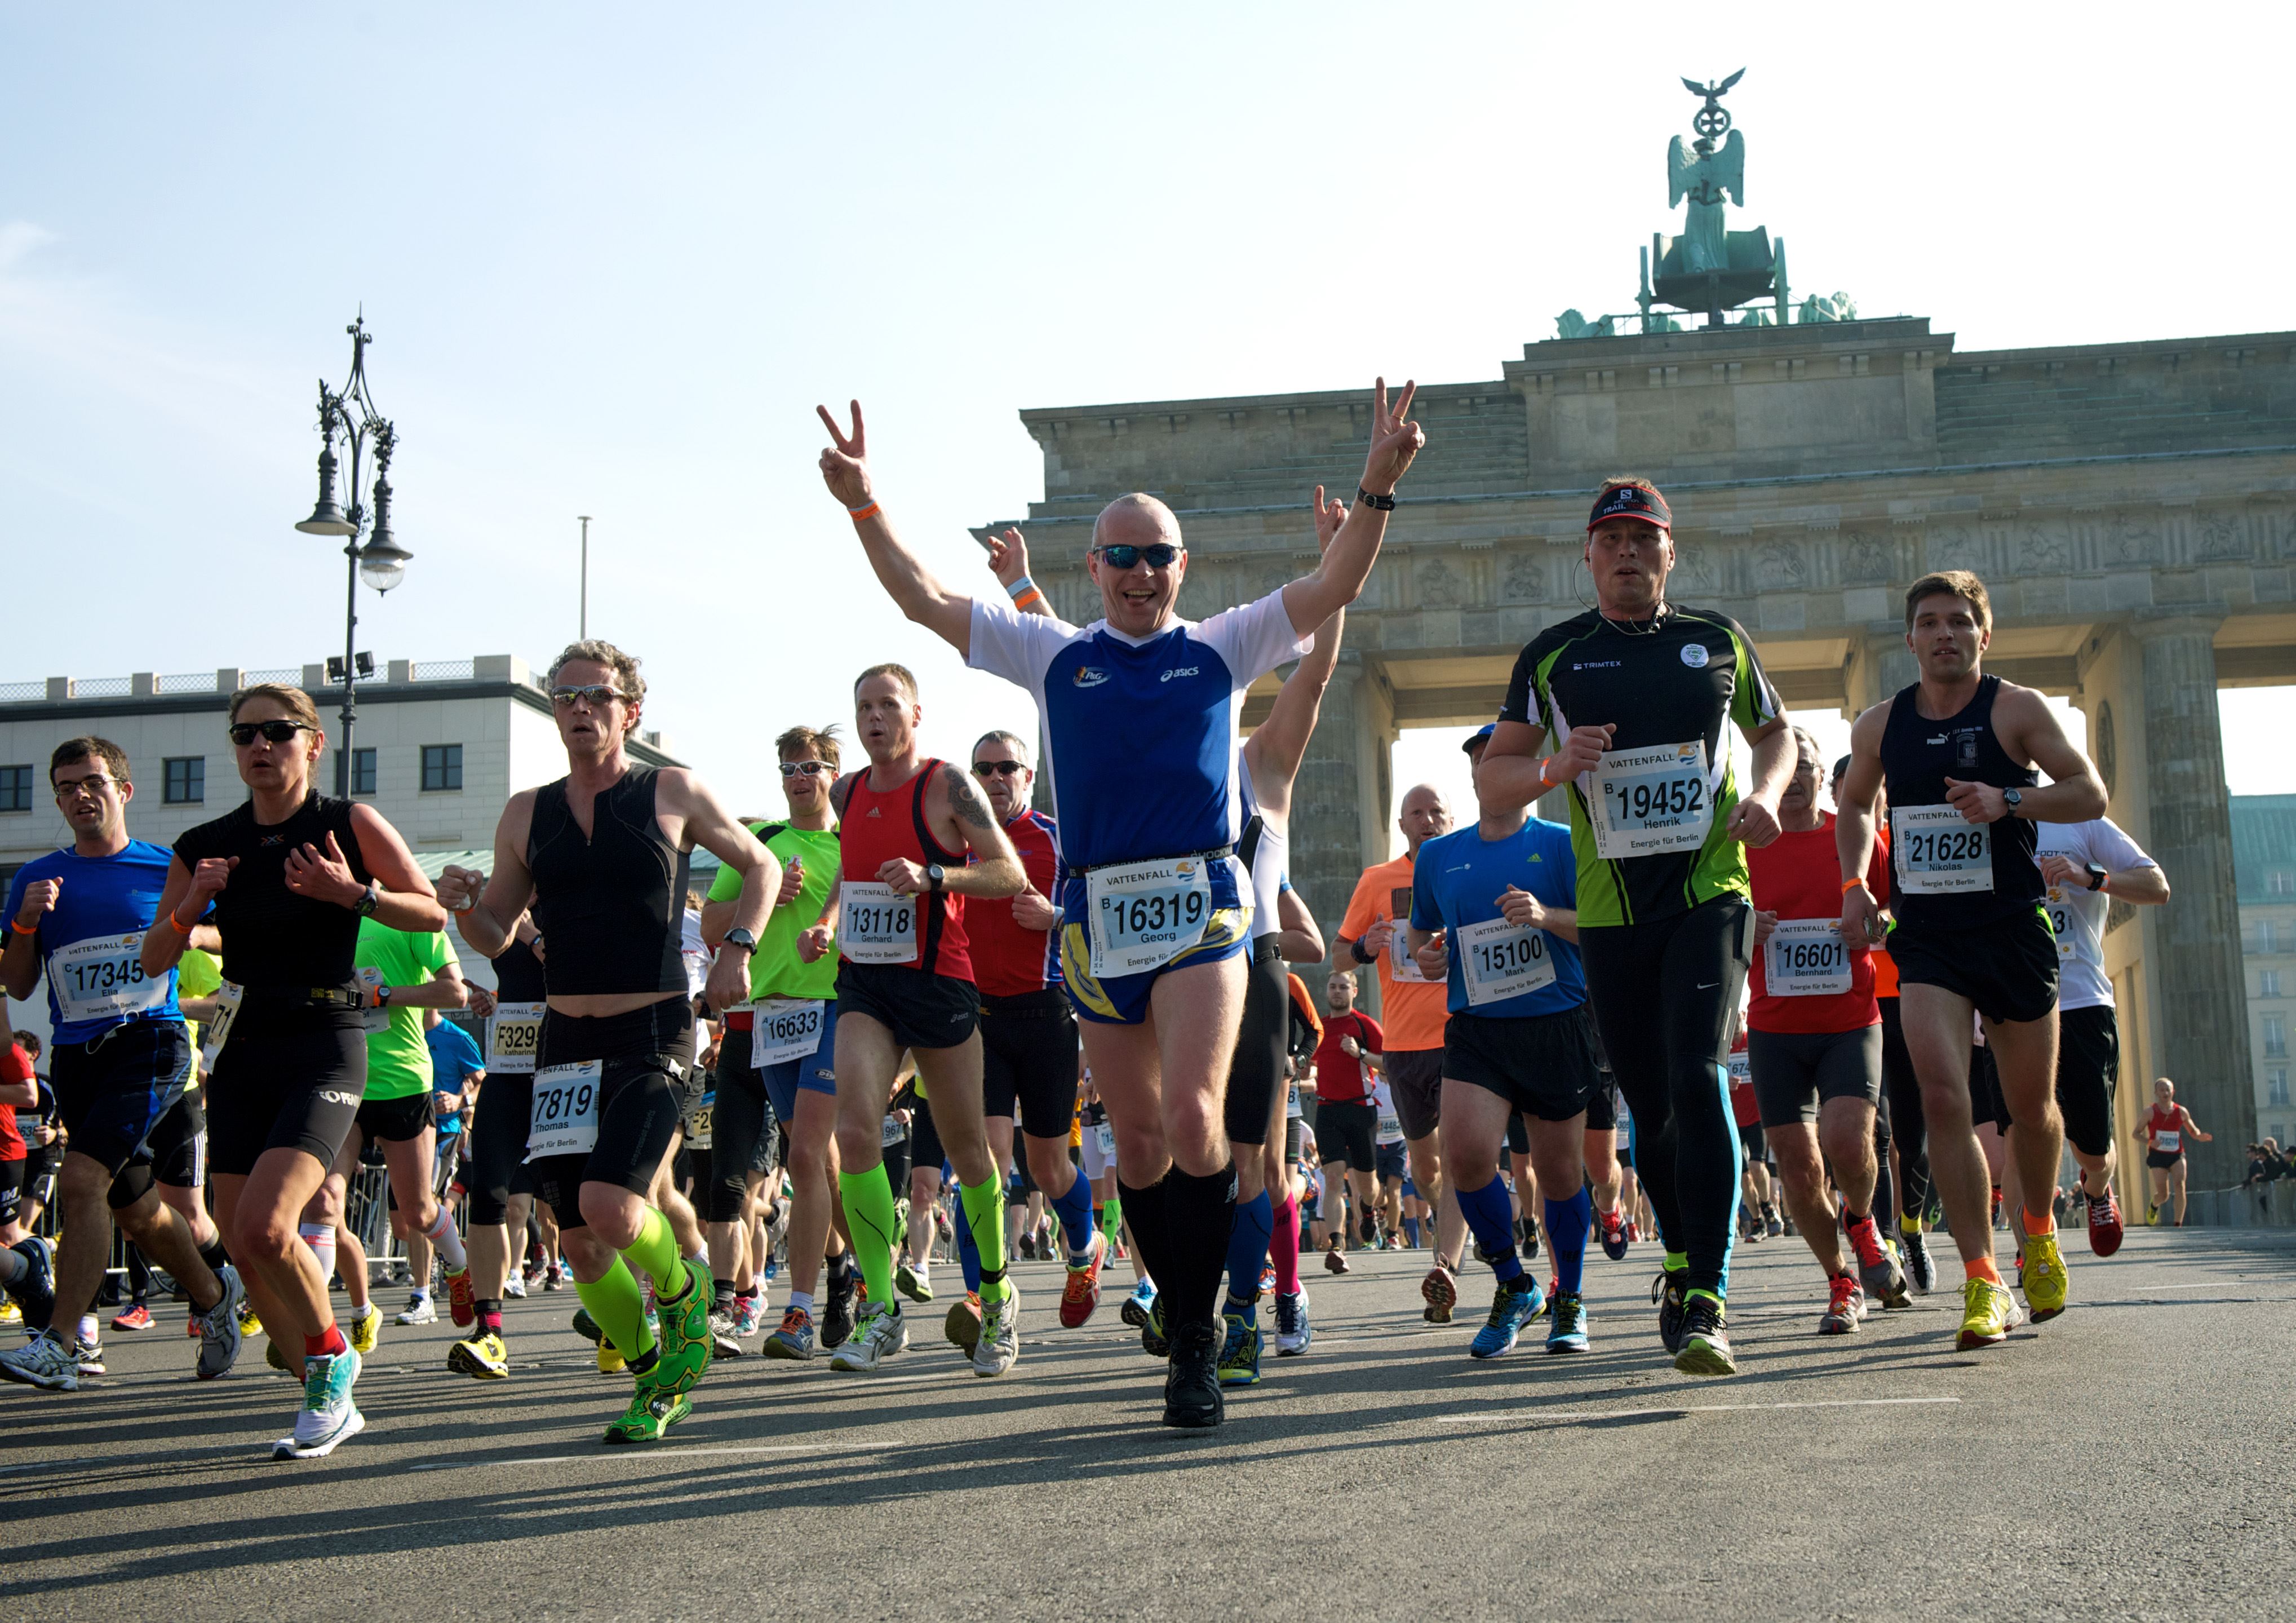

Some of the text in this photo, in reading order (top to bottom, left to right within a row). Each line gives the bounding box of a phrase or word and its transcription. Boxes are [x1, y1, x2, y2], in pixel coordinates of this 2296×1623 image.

[1085, 671, 1103, 680] P&G
[1609, 754, 1675, 768] VATTENFALL
[1604, 778, 1703, 820] B 19452
[1644, 817, 1681, 829] Henrik
[1908, 811, 1960, 821] VATTENFALL
[1631, 839, 1660, 848] Energie
[1677, 834, 1699, 842] Berlin
[1905, 831, 1982, 862] B 21628
[1929, 863, 1962, 872] Nikolas
[1106, 869, 1172, 885] VATTENFALL
[1101, 891, 1203, 935] B 16319
[853, 908, 910, 934] 13118
[1141, 932, 1176, 944] Georg
[69, 942, 120, 955] VATTENFALL
[1482, 935, 1542, 971] 15100
[1784, 943, 1842, 968] 16601
[1128, 955, 1156, 966] Energie
[65, 959, 144, 991] C 17345
[1505, 967, 1526, 978] Mark
[1494, 985, 1516, 994] Energie
[1526, 977, 1543, 987] Berlin
[87, 1005, 109, 1014] Energie
[211, 1004, 233, 1037] 71
[768, 1011, 818, 1040] 16633
[497, 1025, 539, 1047] F329
[784, 1037, 802, 1045] Frank
[773, 1051, 789, 1059] Energie
[533, 1085, 592, 1122] 7819
[535, 1121, 569, 1133] Thomas
[532, 1138, 578, 1151] ergie für Berlin
